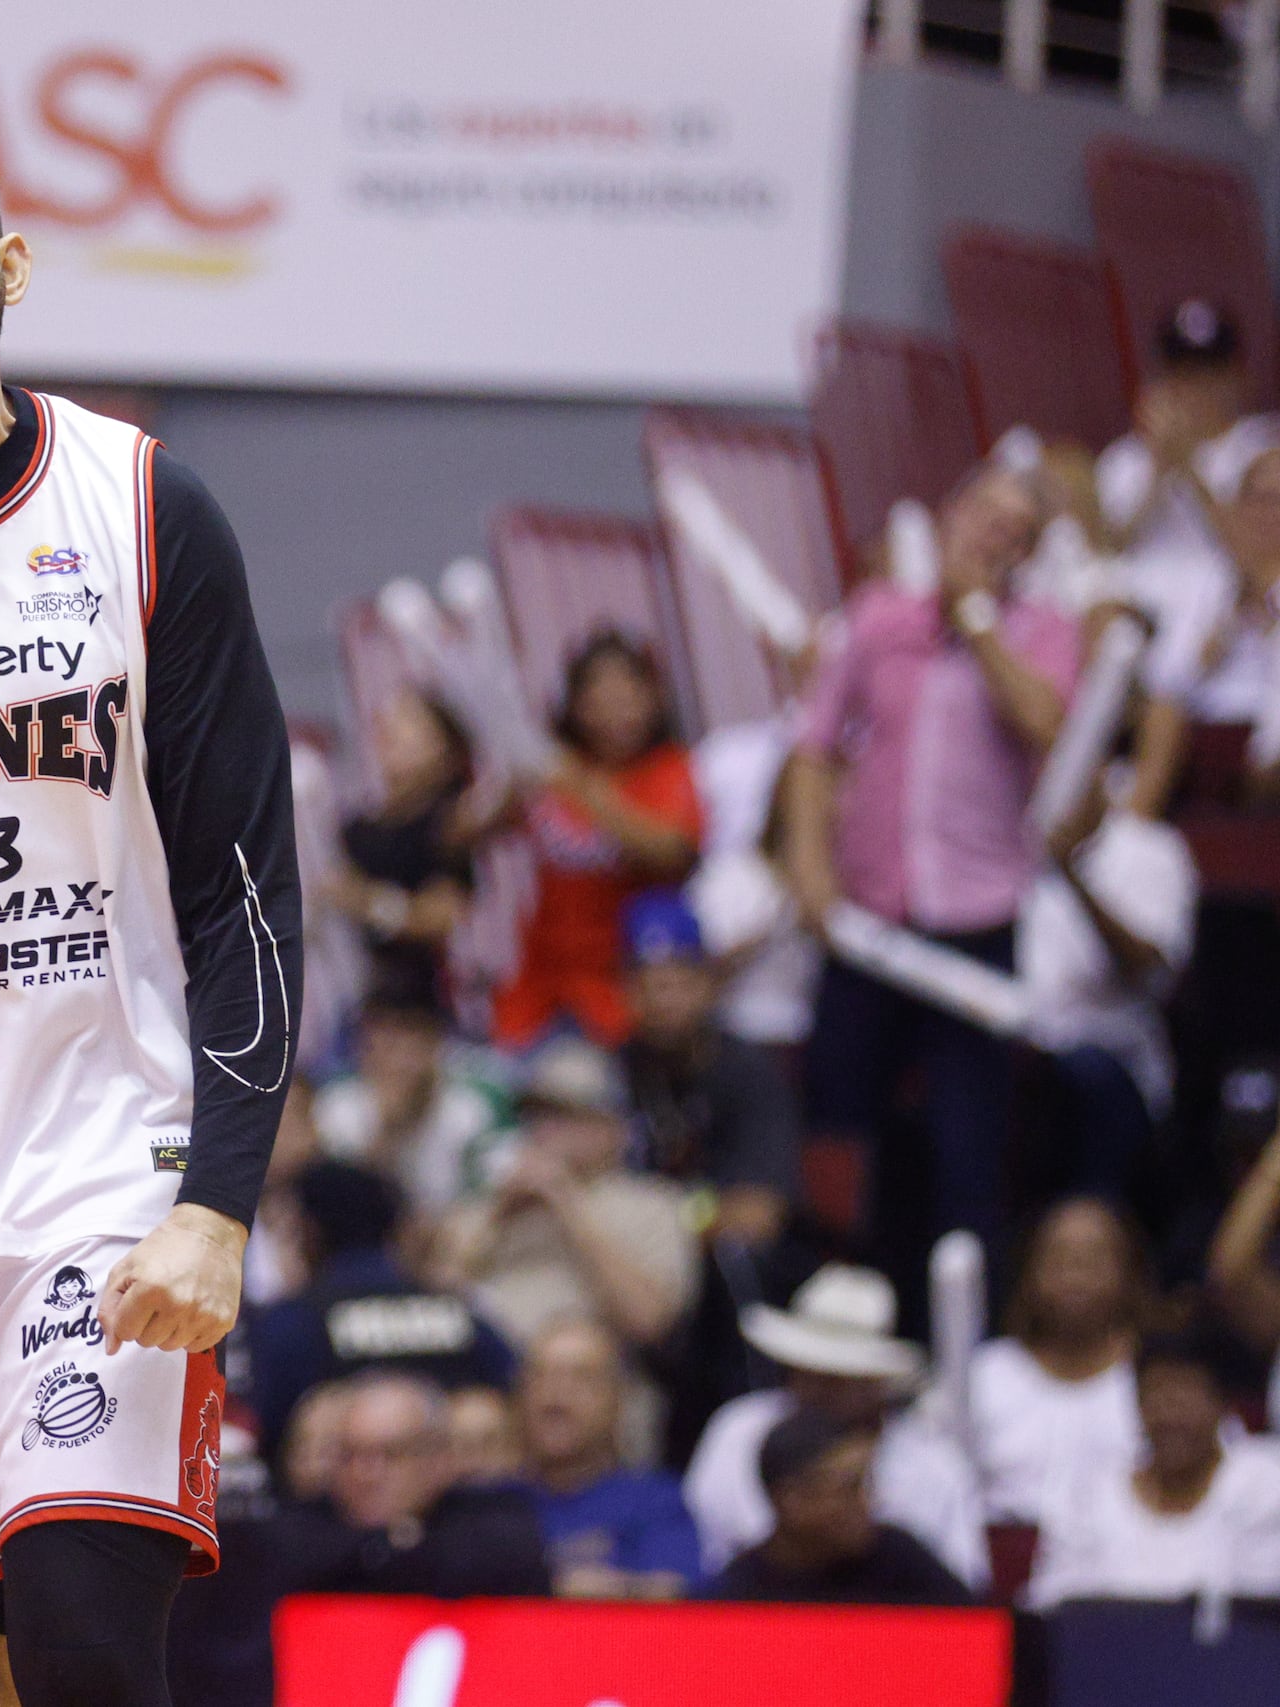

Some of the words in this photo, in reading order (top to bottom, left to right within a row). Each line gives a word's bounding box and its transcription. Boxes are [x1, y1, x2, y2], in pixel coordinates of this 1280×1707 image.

[16, 598, 85, 614] TURISMO
[22, 612, 60, 622] PUERTO
[63, 612, 87, 621] RICO
[23, 967, 106, 987] RENTAL
[159, 1148, 178, 1158] AC
[22, 1305, 104, 1360] Wendy
[32, 1361, 77, 1410] LOTERÍA
[42, 1437, 57, 1448] DE
[58, 1427, 105, 1449] PUERTO
[103, 1397, 118, 1426] RICO
